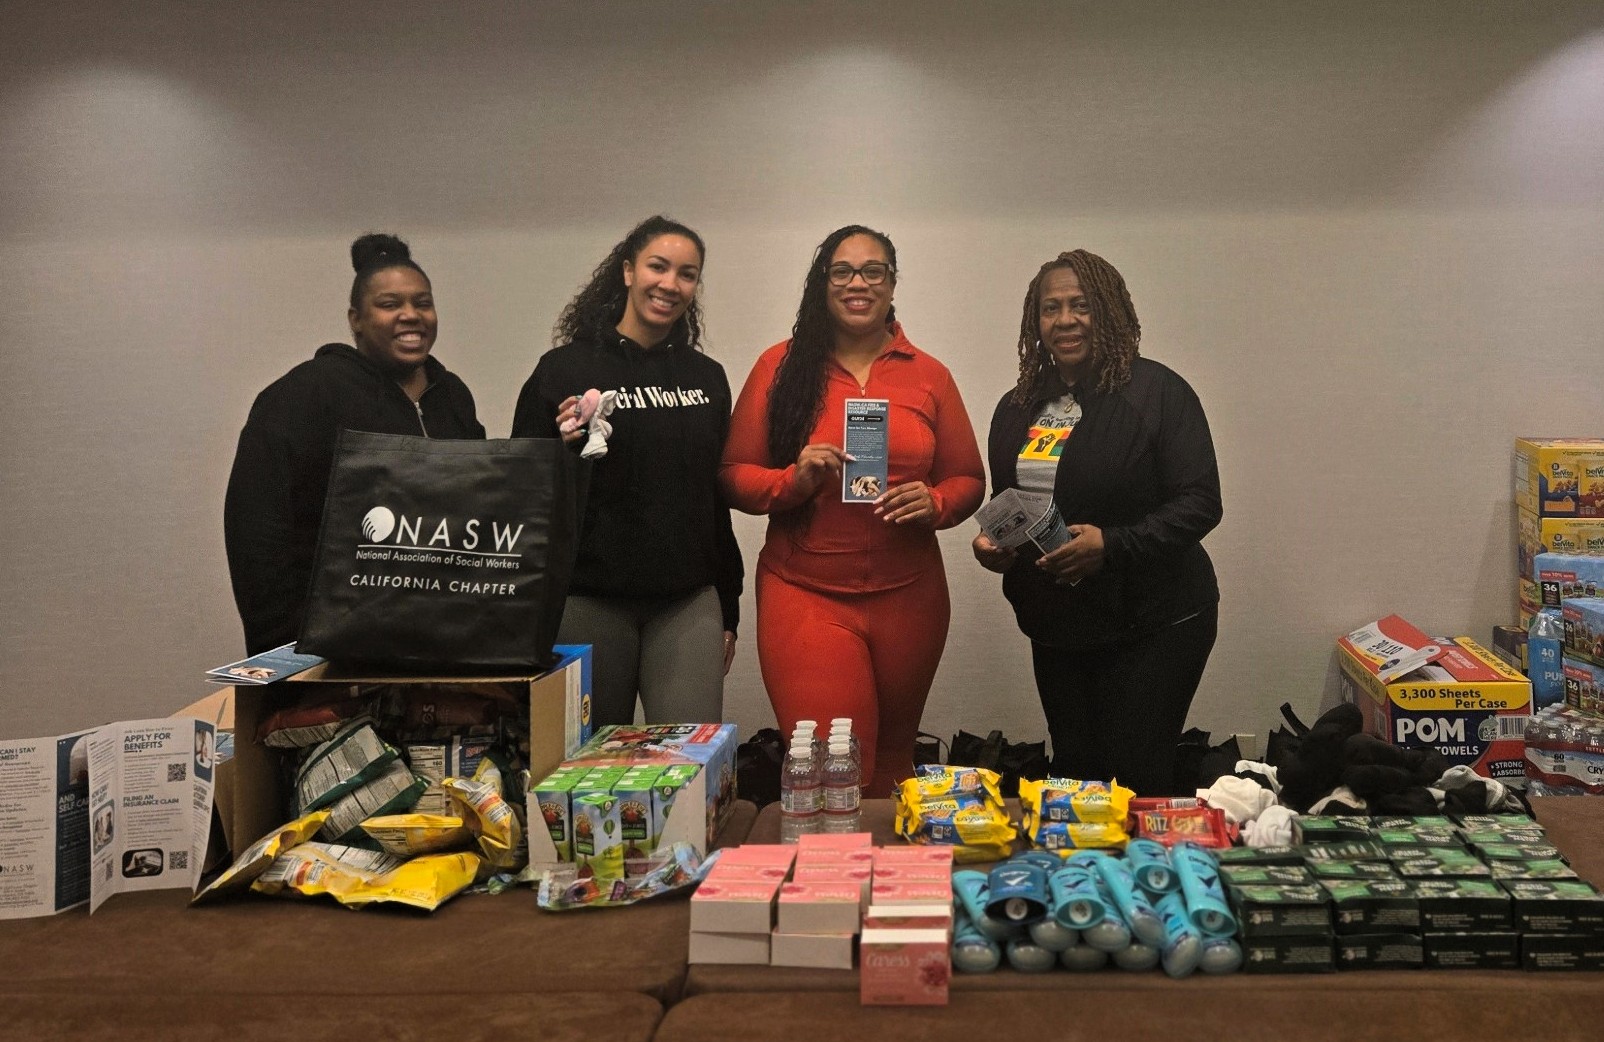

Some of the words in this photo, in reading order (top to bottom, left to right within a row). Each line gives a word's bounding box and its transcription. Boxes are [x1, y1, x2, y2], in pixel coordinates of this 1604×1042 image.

[644, 386, 710, 409] Worker.
[396, 514, 524, 553] NASW
[355, 550, 391, 562] National
[392, 551, 442, 564] Association
[444, 555, 454, 565] of
[455, 555, 484, 568] Social
[485, 558, 520, 570] Workers
[350, 574, 441, 591] CALIFORNIA
[449, 580, 516, 596] CHAPTER
[1543, 583, 1558, 592] 36
[1541, 647, 1555, 658] 40
[1567, 679, 1578, 692] 36
[1399, 688, 1436, 700] 3,300
[1439, 688, 1481, 698] Sheets
[1455, 699, 1477, 708] Per
[1479, 699, 1507, 709] Case
[1396, 717, 1466, 743] POM
[124, 733, 152, 743] APPLY
[154, 732, 172, 740] FOR
[19, 746, 36, 754] STAY
[124, 741, 163, 750] BENEFITS
[1494, 761, 1523, 769] STRONG
[1587, 765, 1604, 775] CRY
[1495, 769, 1524, 777] ABSORBE
[1042, 777, 1079, 786] belVita
[58, 793, 75, 805] AND
[123, 799, 158, 808] INSURANCE
[919, 800, 957, 810] belVita
[1144, 815, 1170, 832] RITZ
[3, 864, 35, 873] NASW
